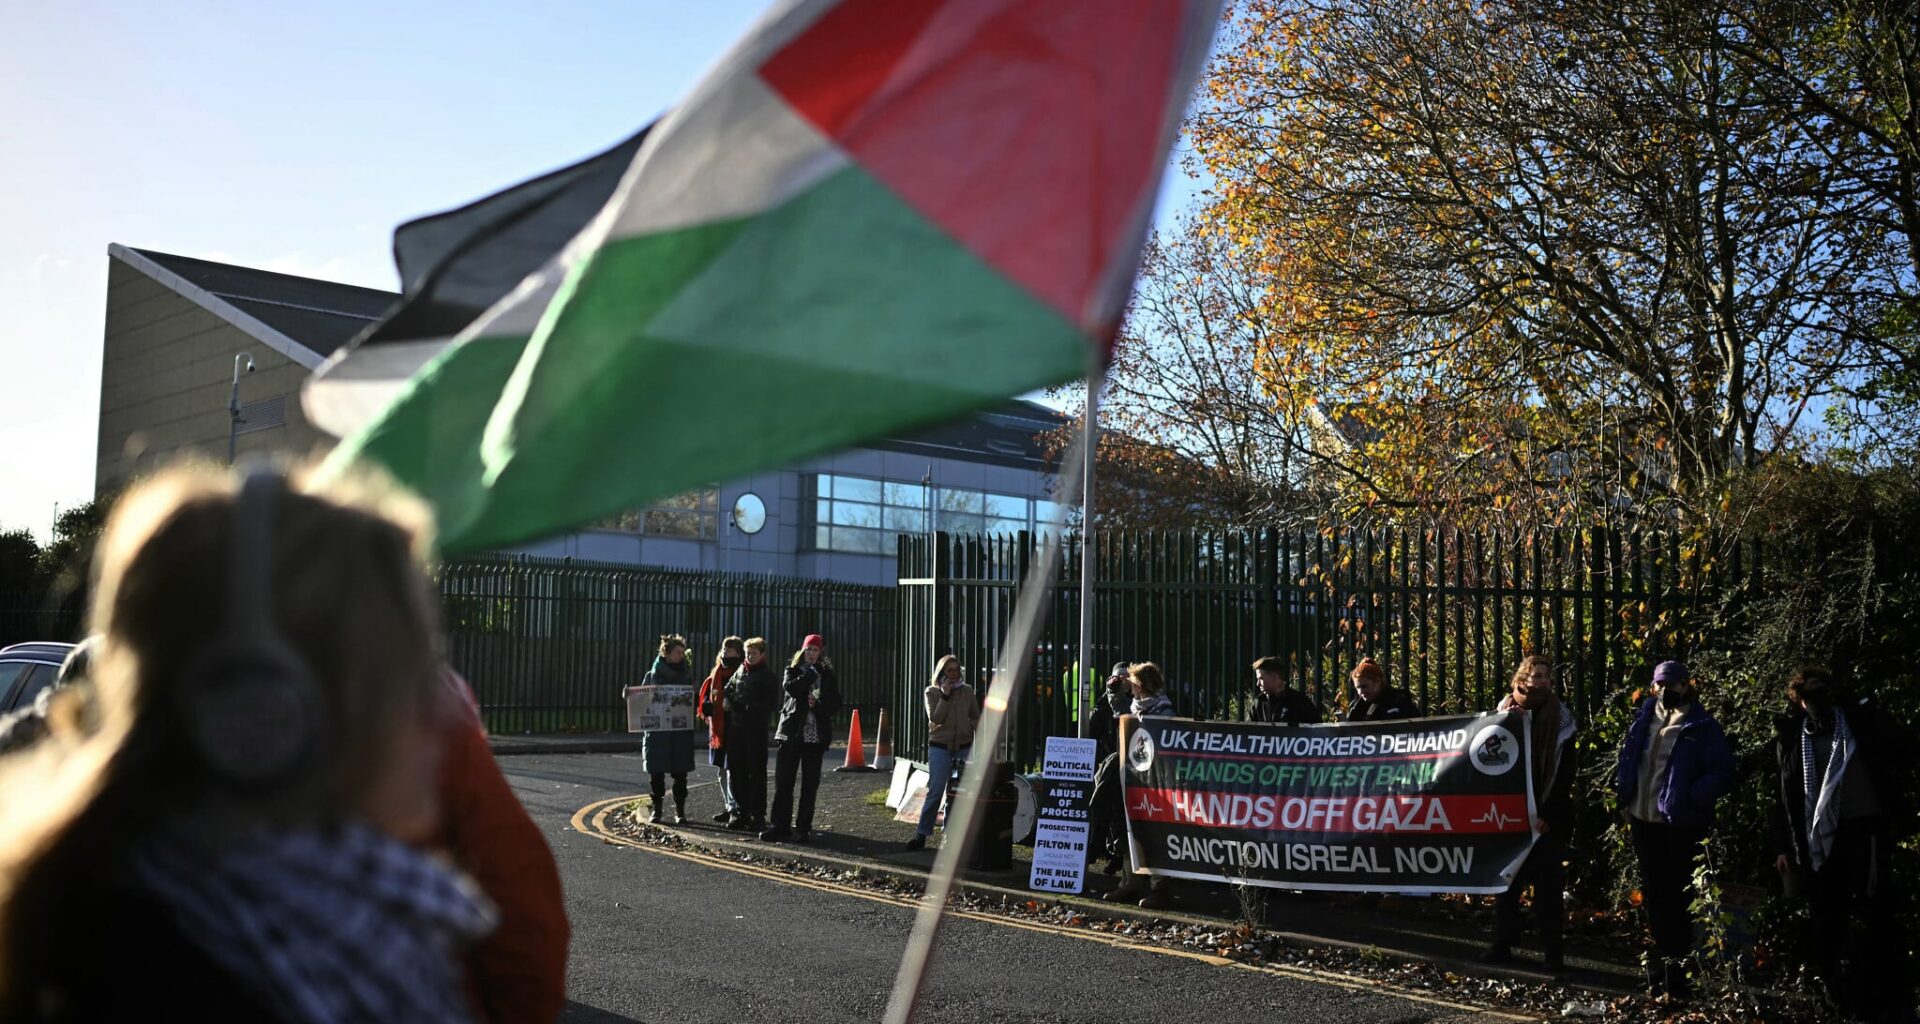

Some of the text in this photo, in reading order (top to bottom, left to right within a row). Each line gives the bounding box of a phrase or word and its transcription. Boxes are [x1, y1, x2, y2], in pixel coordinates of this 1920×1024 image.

[1160, 729, 1467, 756] UK HEALTHWORKERS DEMAND
[1047, 745, 1094, 754] DOCUMENTS
[1046, 760, 1092, 771] POLITICAL
[1044, 770, 1091, 779] INTERFERENCE
[1175, 759, 1440, 788] HANDS OFF WEST BANK
[1050, 788, 1083, 798] ABUSE
[1058, 799, 1072, 807] OF
[1041, 807, 1088, 818] PROCESS
[1171, 791, 1453, 831] HANDS OFF GAZA
[1039, 823, 1086, 833] PROSECTIONS
[1037, 839, 1084, 851] FILTON 18
[1166, 834, 1475, 874] SANCTION ISREAL NOW
[1036, 867, 1079, 879] THE RULE
[1034, 877, 1077, 890] OF LAW.
